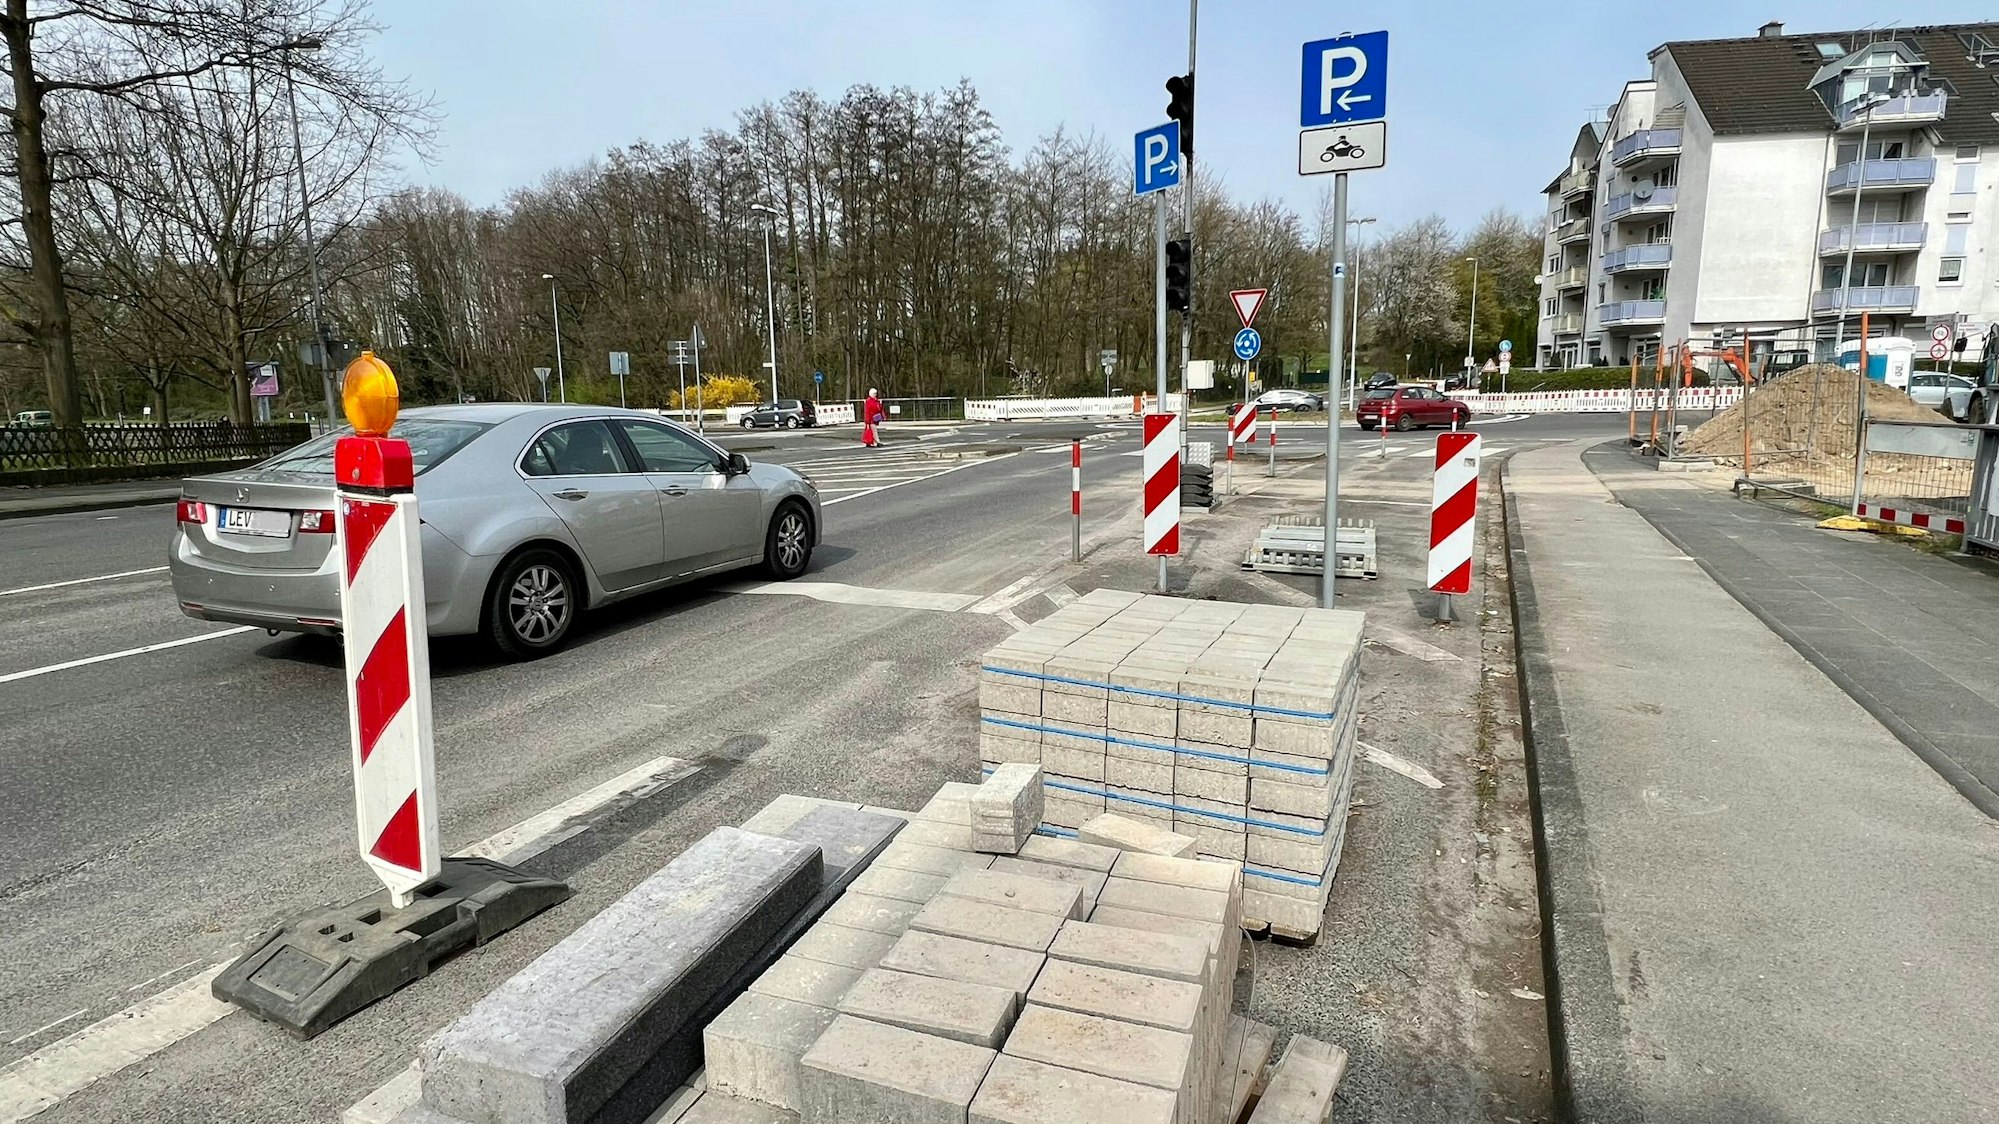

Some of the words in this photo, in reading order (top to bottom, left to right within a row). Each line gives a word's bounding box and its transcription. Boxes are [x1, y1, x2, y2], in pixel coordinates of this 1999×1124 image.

[1320, 47, 1367, 115] P
[1145, 134, 1169, 185] P
[229, 511, 252, 527] LEV
